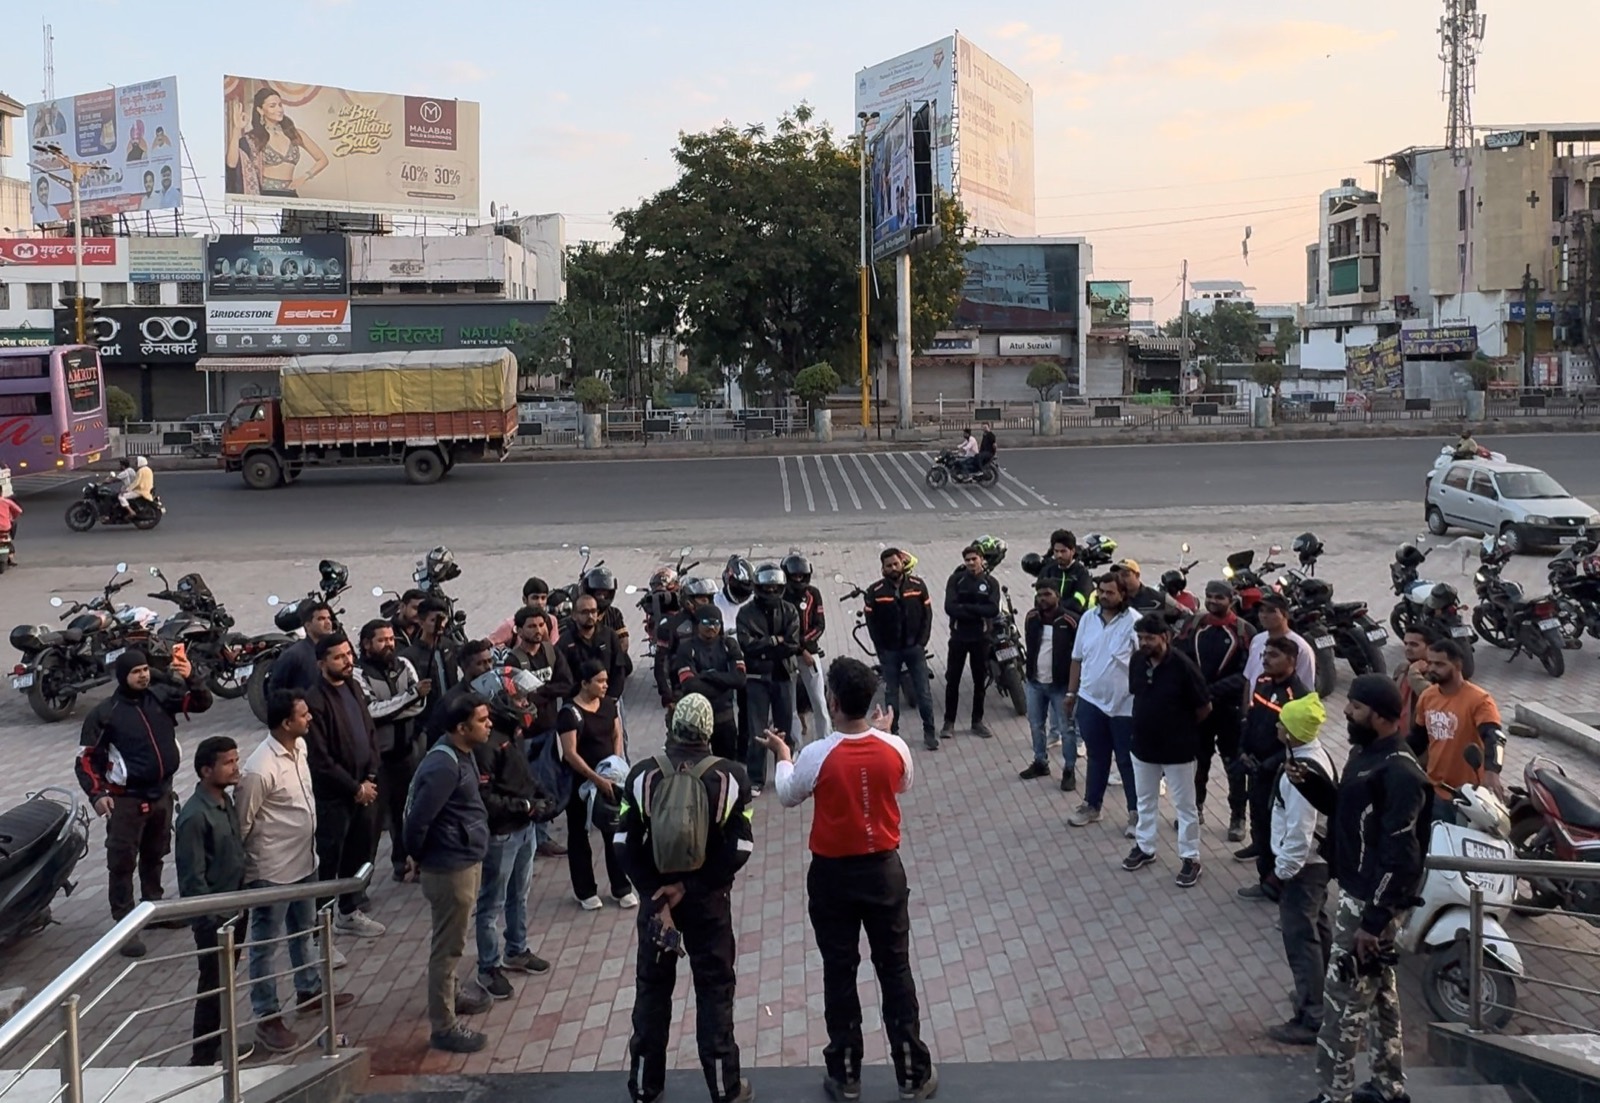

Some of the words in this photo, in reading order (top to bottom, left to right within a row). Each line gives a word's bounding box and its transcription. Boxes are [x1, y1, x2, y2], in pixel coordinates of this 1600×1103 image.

[350, 105, 378, 122] Big
[328, 119, 392, 139] Brilliant
[409, 125, 453, 136] MALABAR
[333, 134, 381, 156] Sale
[401, 164, 428, 182] 40%
[434, 168, 461, 185] 30%
[253, 236, 302, 244] BRIDGESTONE
[40, 245, 64, 259] मुथूट
[210, 310, 274, 319] BRIDGESTONE
[368, 319, 444, 344] नॅचरल्स
[140, 342, 198, 357] लेन्सकार्ट
[68, 367, 97, 383] AMRUT
